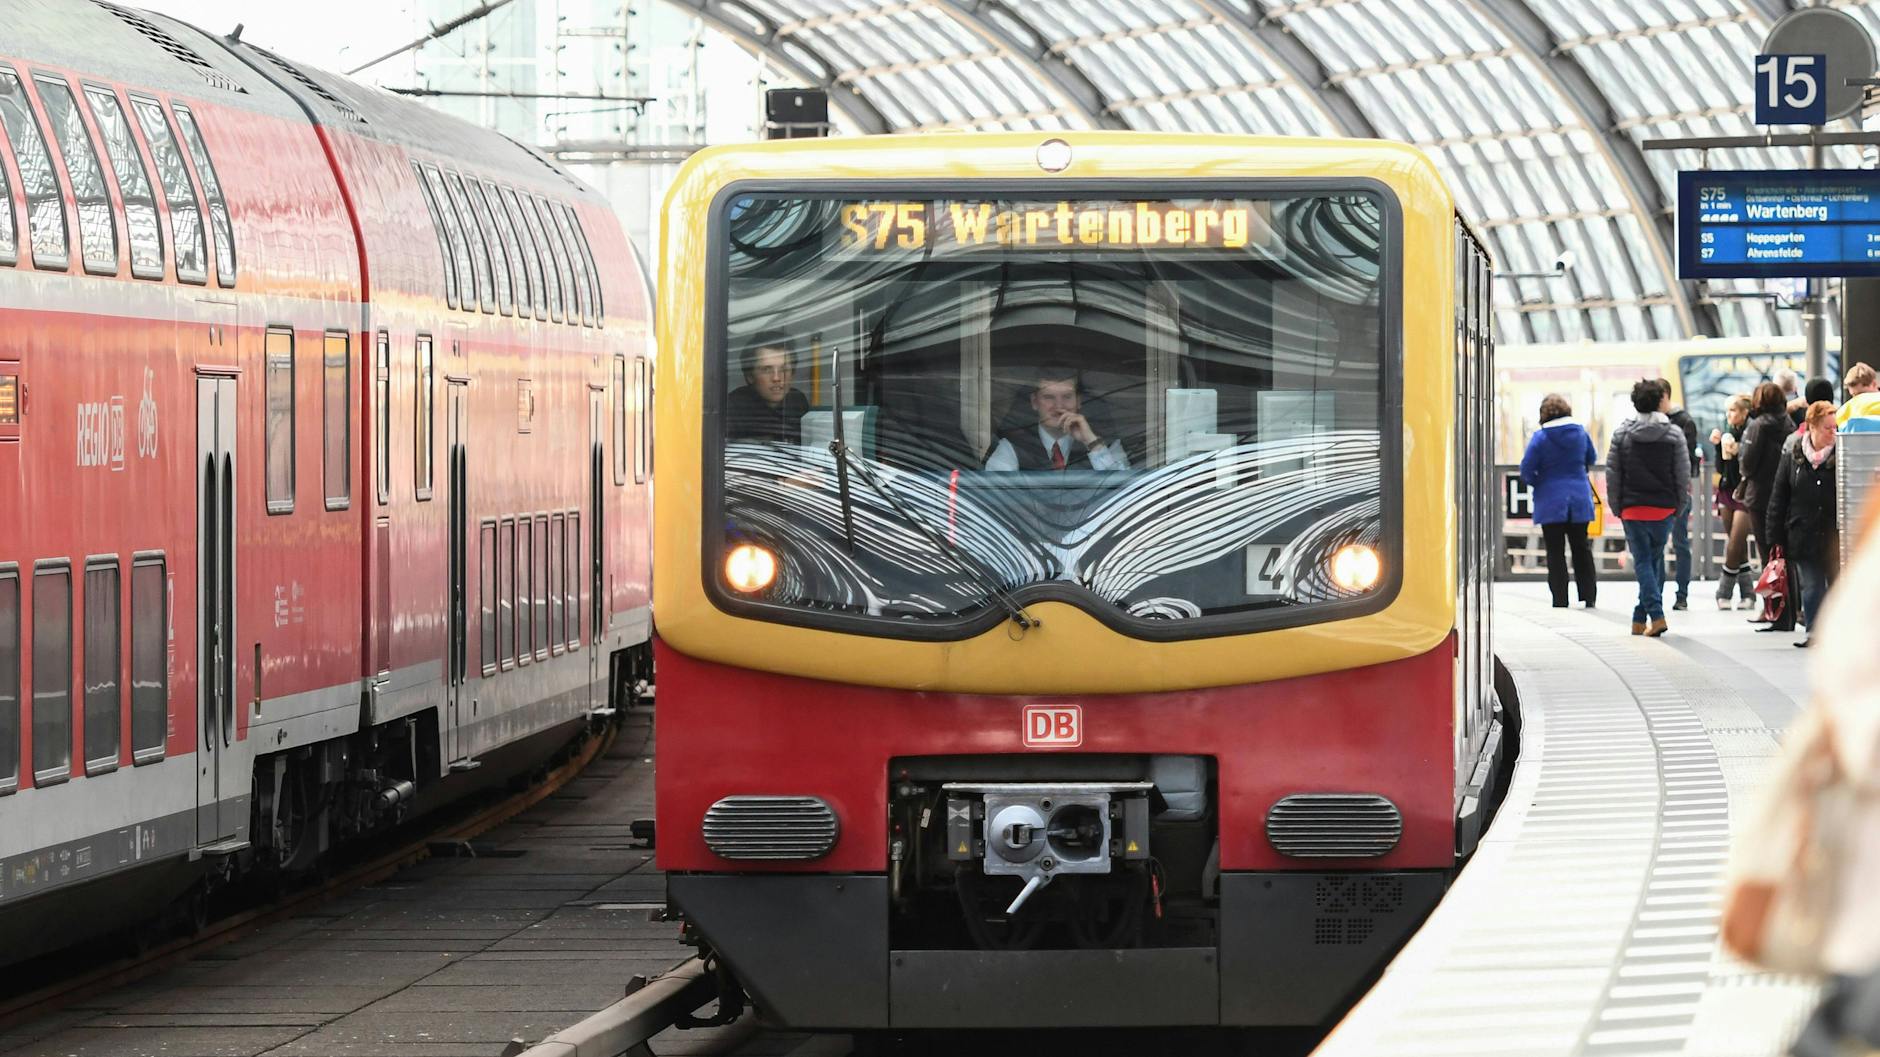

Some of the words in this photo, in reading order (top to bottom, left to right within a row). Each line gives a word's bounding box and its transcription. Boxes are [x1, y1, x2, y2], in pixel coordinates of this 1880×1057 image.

[1757, 56, 1817, 109] 15
[1700, 187, 1726, 201] S75
[841, 203, 926, 249] S75
[950, 202, 1249, 248] Wartenberg
[1746, 204, 1828, 221] Wartenberg
[1701, 233, 1715, 243] S5
[1701, 248, 1715, 258] S7
[77, 402, 109, 467] REGIO
[111, 406, 123, 461] DB
[1258, 547, 1285, 590] 4
[1029, 710, 1076, 741] DB
